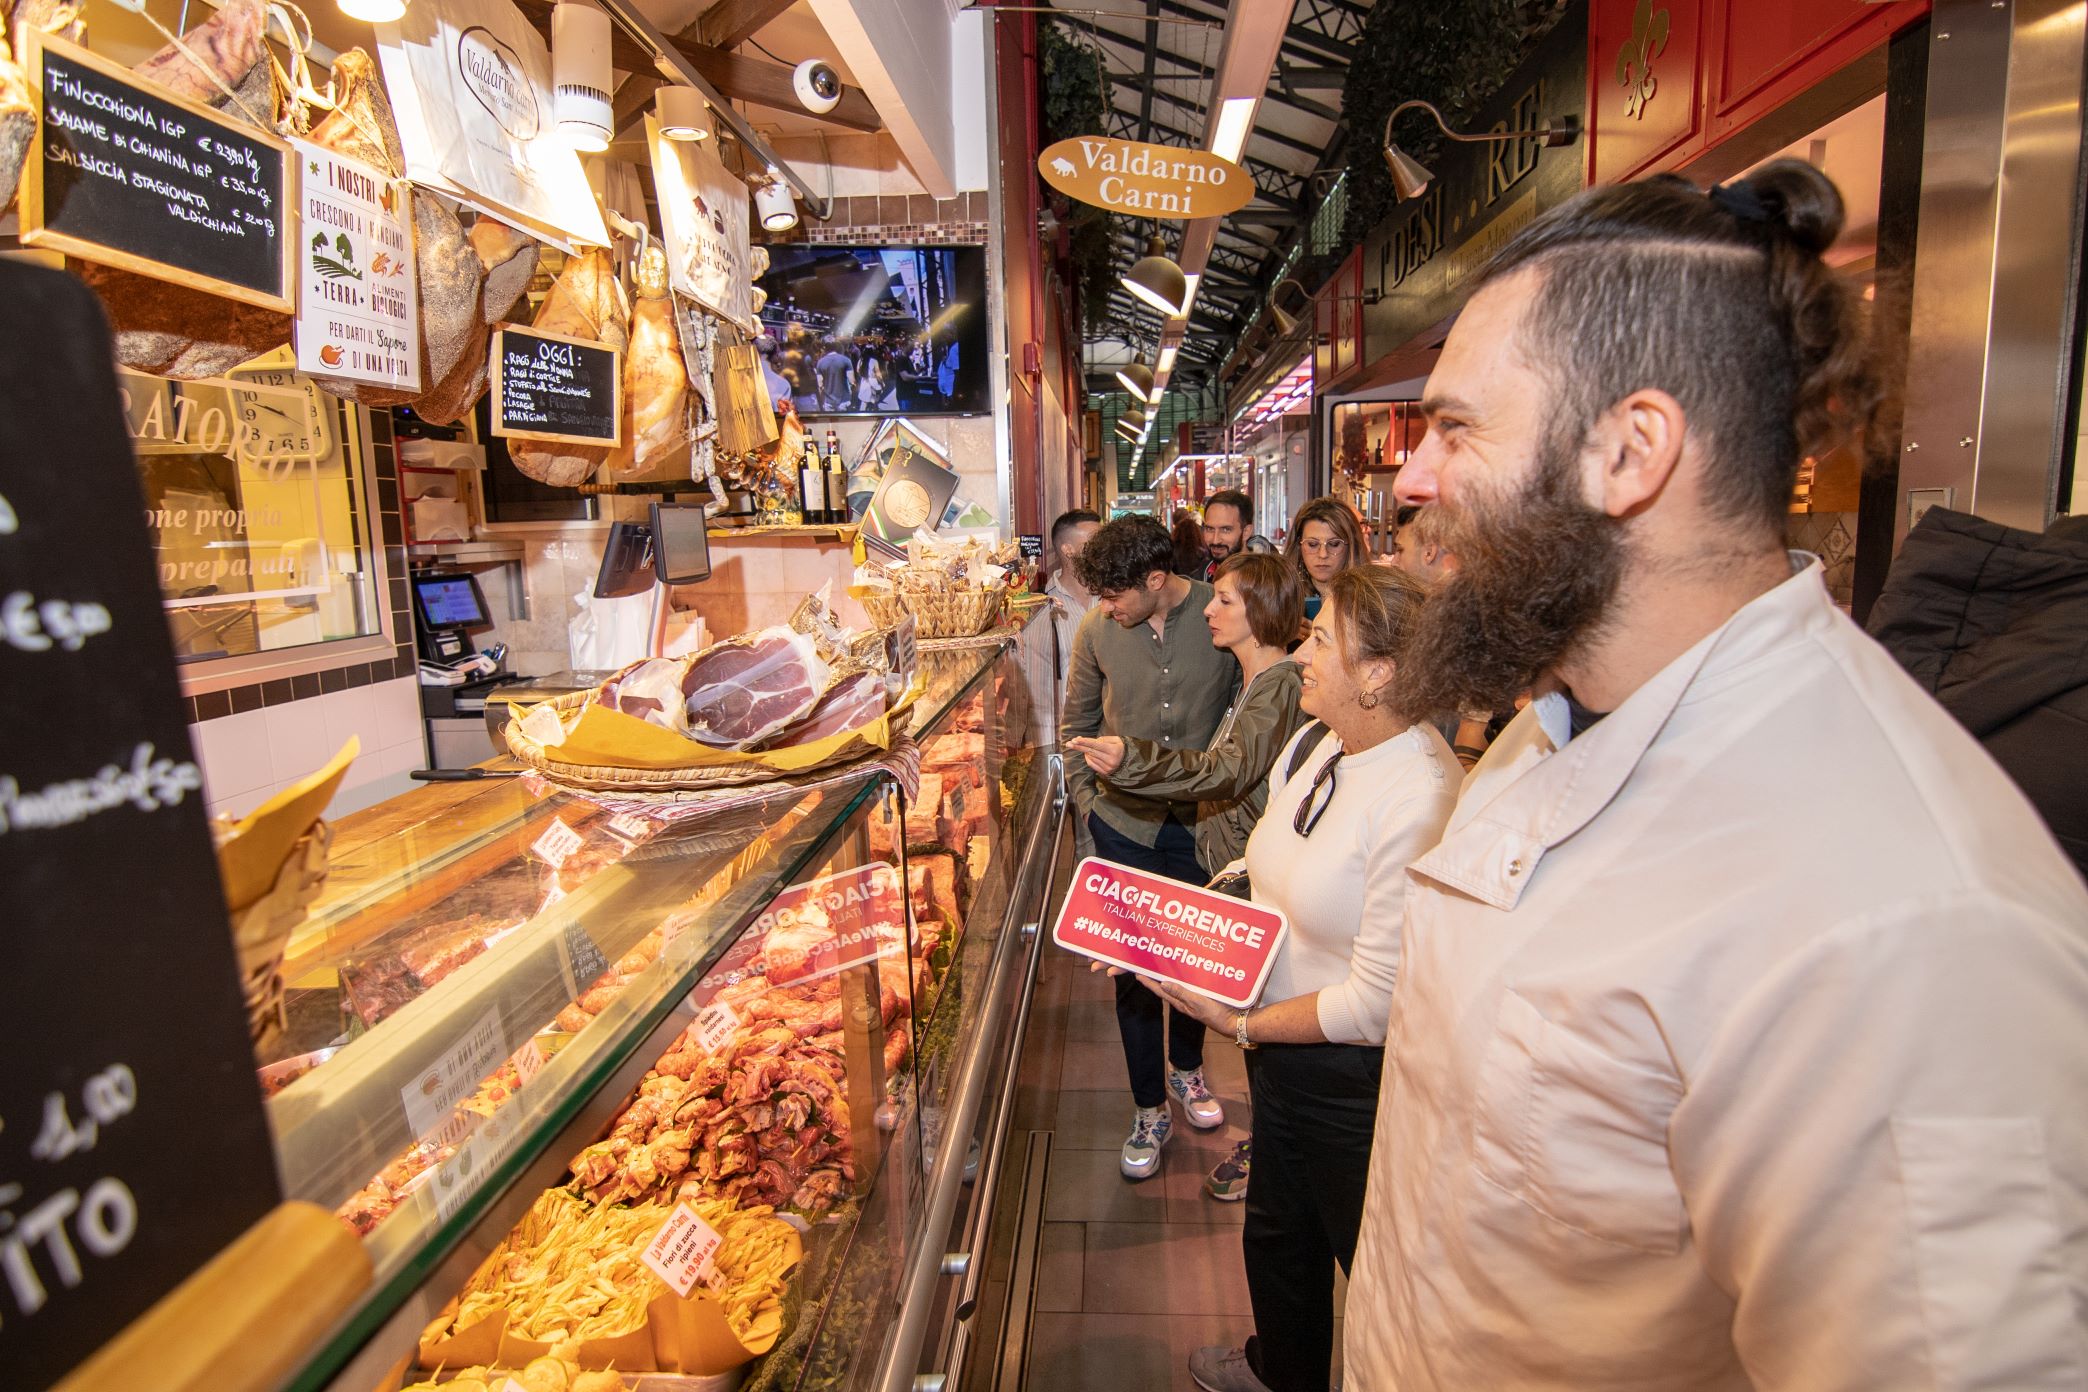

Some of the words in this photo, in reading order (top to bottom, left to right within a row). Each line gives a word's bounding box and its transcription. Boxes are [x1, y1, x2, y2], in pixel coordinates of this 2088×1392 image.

[161, 117, 186, 139] IGP
[192, 162, 213, 177] IGP
[1079, 140, 1227, 186] Valdarno
[328, 161, 333, 187] I
[337, 165, 376, 204] NOSTRI
[1099, 176, 1193, 214] Carni
[310, 198, 354, 232] CRESCONO
[357, 216, 362, 234] A
[369, 220, 404, 252] MNGIANO
[323, 280, 358, 306] TERRA
[372, 282, 406, 301] ALIMENTI
[372, 294, 407, 320] BIOLOGICI
[329, 321, 344, 338] PER
[346, 324, 366, 343] DARTI
[369, 330, 374, 345] IL
[377, 329, 408, 355] Sapore
[353, 350, 361, 369] DI
[366, 353, 383, 373] UNA
[386, 357, 409, 377] VOLTA
[1103, 901, 1146, 928] ITALIAN
[1147, 917, 1226, 953] EXPERIENCES
[1073, 916, 1246, 982] #WeAreCiaoFlorence
[662, 1250, 678, 1268] Fiori
[676, 1243, 683, 1252] di
[681, 1223, 697, 1244] zucca
[680, 1241, 697, 1264] ripieni
[680, 1276, 688, 1285] €
[685, 1252, 704, 1277] 19,90
[708, 1238, 717, 1249] kg
